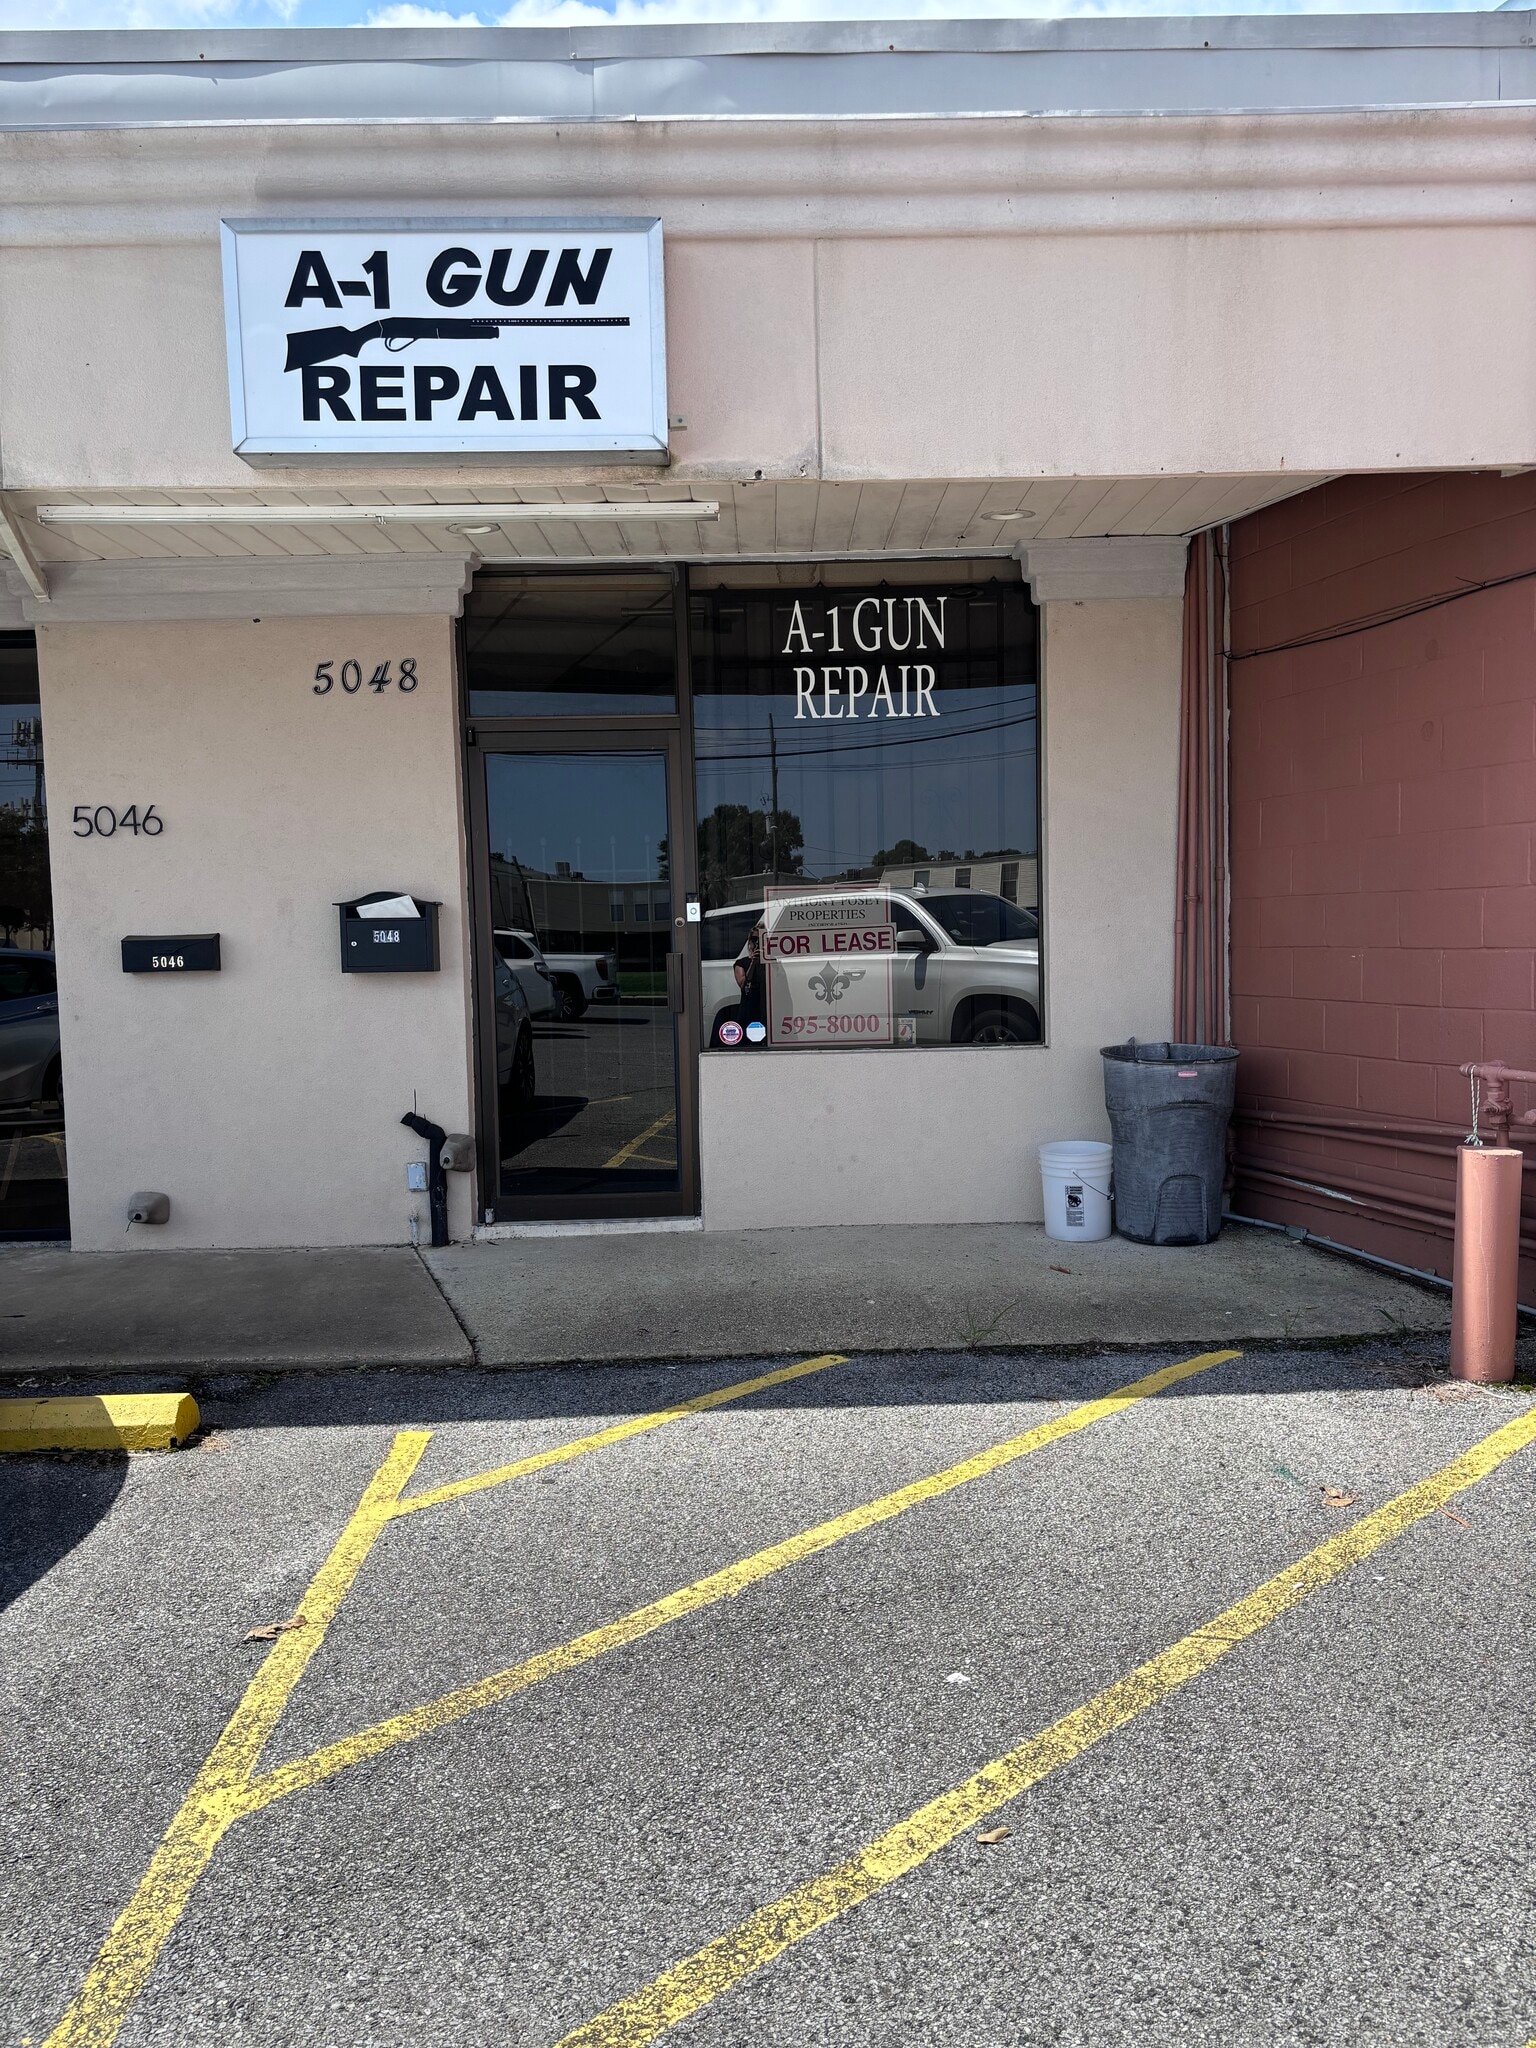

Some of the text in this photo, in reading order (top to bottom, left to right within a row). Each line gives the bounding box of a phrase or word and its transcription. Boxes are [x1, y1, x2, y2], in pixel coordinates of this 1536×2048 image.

[284, 247, 613, 309] A-1 GUN
[301, 364, 602, 421] REPAIR
[782, 597, 947, 653] A-1 GUN
[312, 657, 418, 695] 5048
[793, 664, 941, 719] REPAIR
[72, 804, 164, 837] 5046
[789, 909, 866, 921] PROPERTIES
[373, 930, 400, 943] 5048
[766, 931, 892, 956] FOR LEASE
[152, 955, 184, 968] 5046
[781, 1014, 880, 1035] 595-8000
